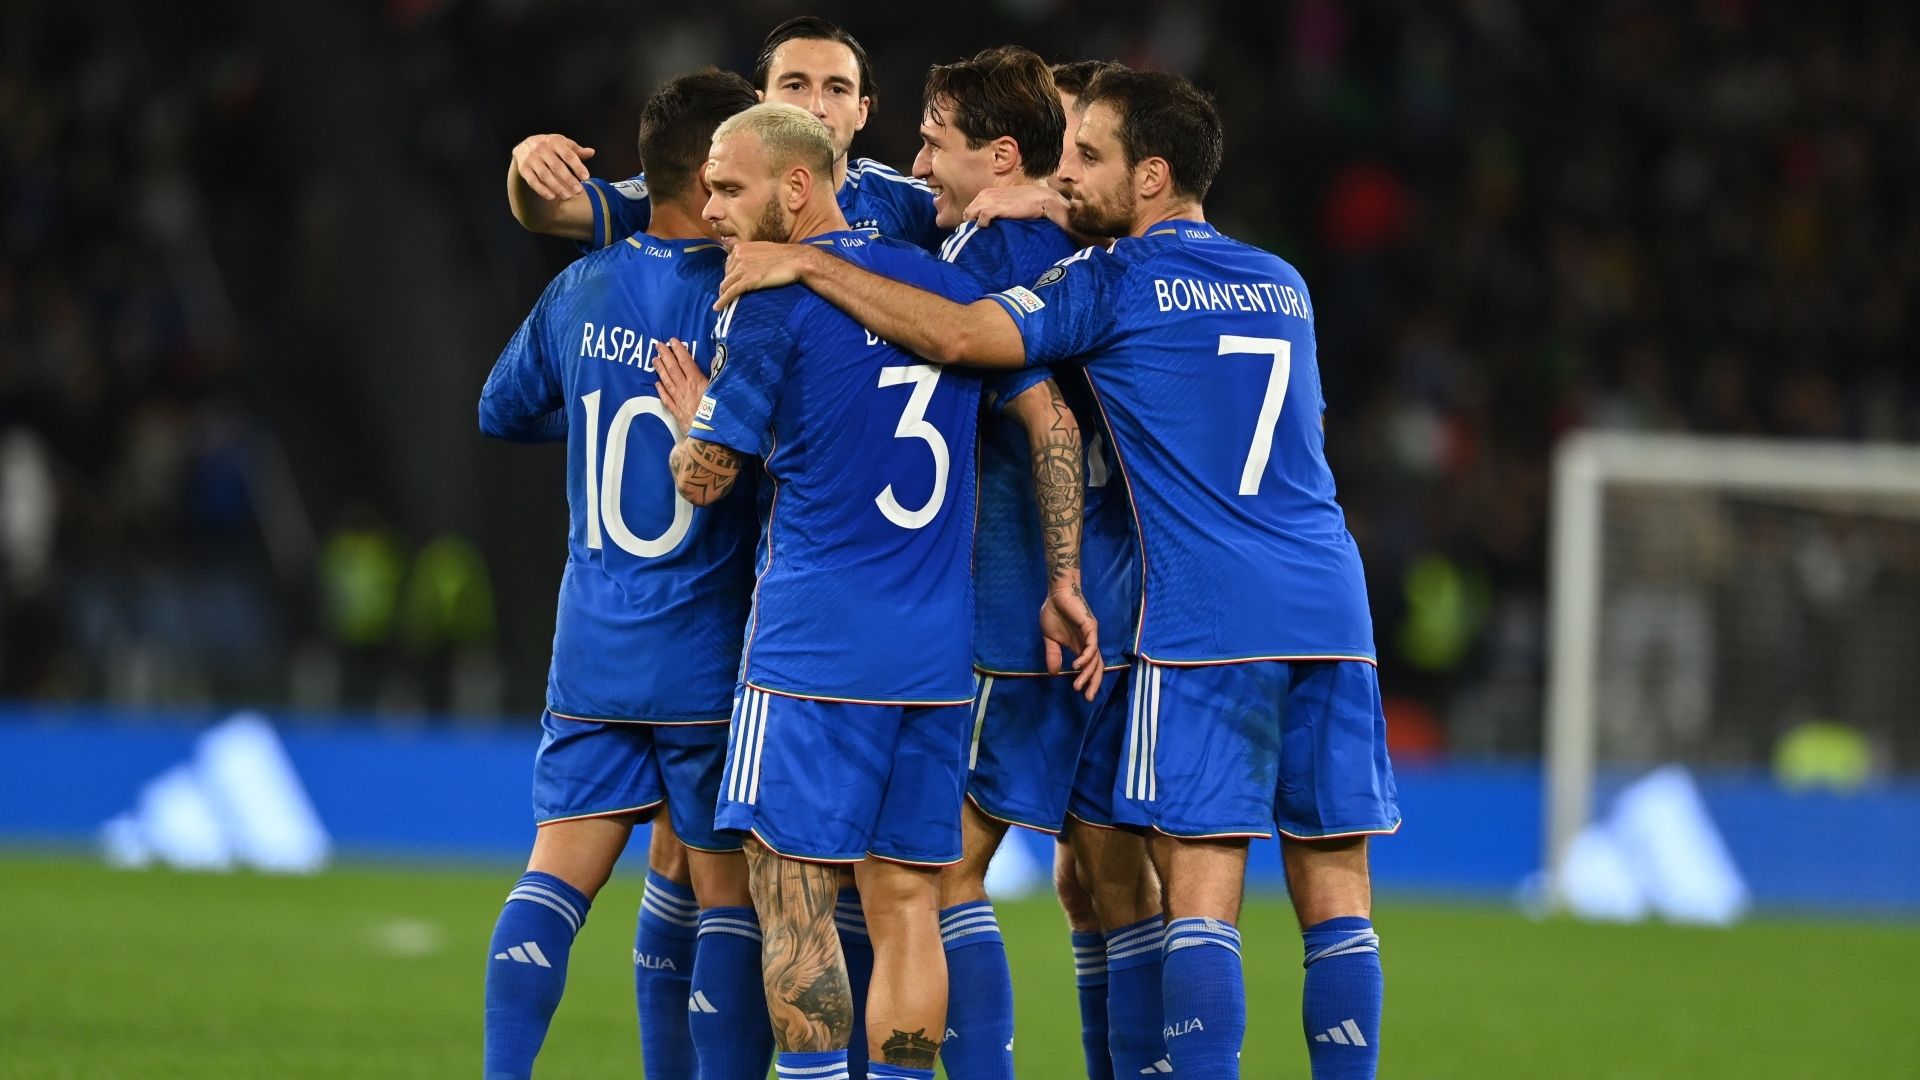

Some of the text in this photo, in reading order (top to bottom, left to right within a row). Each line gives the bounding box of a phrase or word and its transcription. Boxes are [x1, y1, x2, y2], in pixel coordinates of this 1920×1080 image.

[840, 237, 867, 248] ITALIA
[1185, 229, 1212, 239] ITALIA
[644, 245, 672, 258] ITALIA
[1154, 278, 1311, 321] BONAVENTURA
[580, 322, 698, 373] RASPADI
[1217, 334, 1291, 496] 7
[874, 364, 949, 530] 3
[581, 389, 694, 558] 10
[633, 948, 676, 970] TALIA
[1163, 1017, 1203, 1042] TALIA
